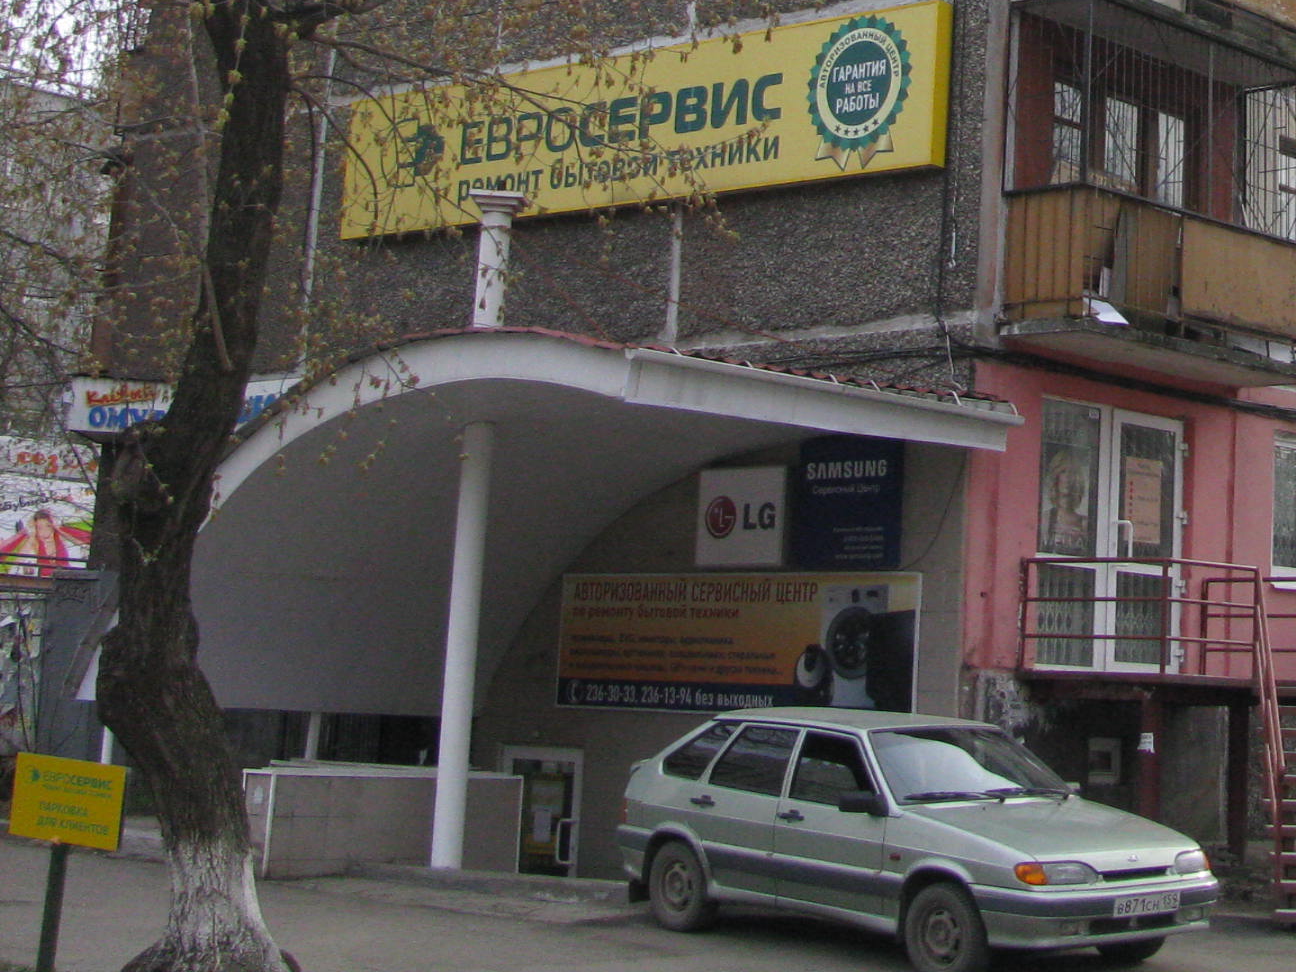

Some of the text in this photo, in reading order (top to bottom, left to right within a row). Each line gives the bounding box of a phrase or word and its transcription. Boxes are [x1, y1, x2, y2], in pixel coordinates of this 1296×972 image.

[819, 30, 900, 89] АВТОРИЗОВАННЫЙ ЦЕНТР
[832, 59, 887, 83] ГАРАНТИЯ
[845, 80, 873, 94] НА ВСЕ
[836, 93, 880, 115] РАБОТЫ
[460, 73, 784, 166] ЕВРОСЕРВИС
[458, 168, 544, 207] ремонт
[806, 459, 888, 481] SAMSUNG
[743, 502, 776, 530] LG
[574, 579, 819, 605] АВТОРИЗОВАННЫЙ СЕРВИСНЫЙ ЦЕНТР
[588, 607, 634, 620] ремонту
[638, 604, 687, 620] бытовой
[689, 608, 740, 620] техники
[695, 689, 714, 705] без
[716, 692, 773, 709] выходных
